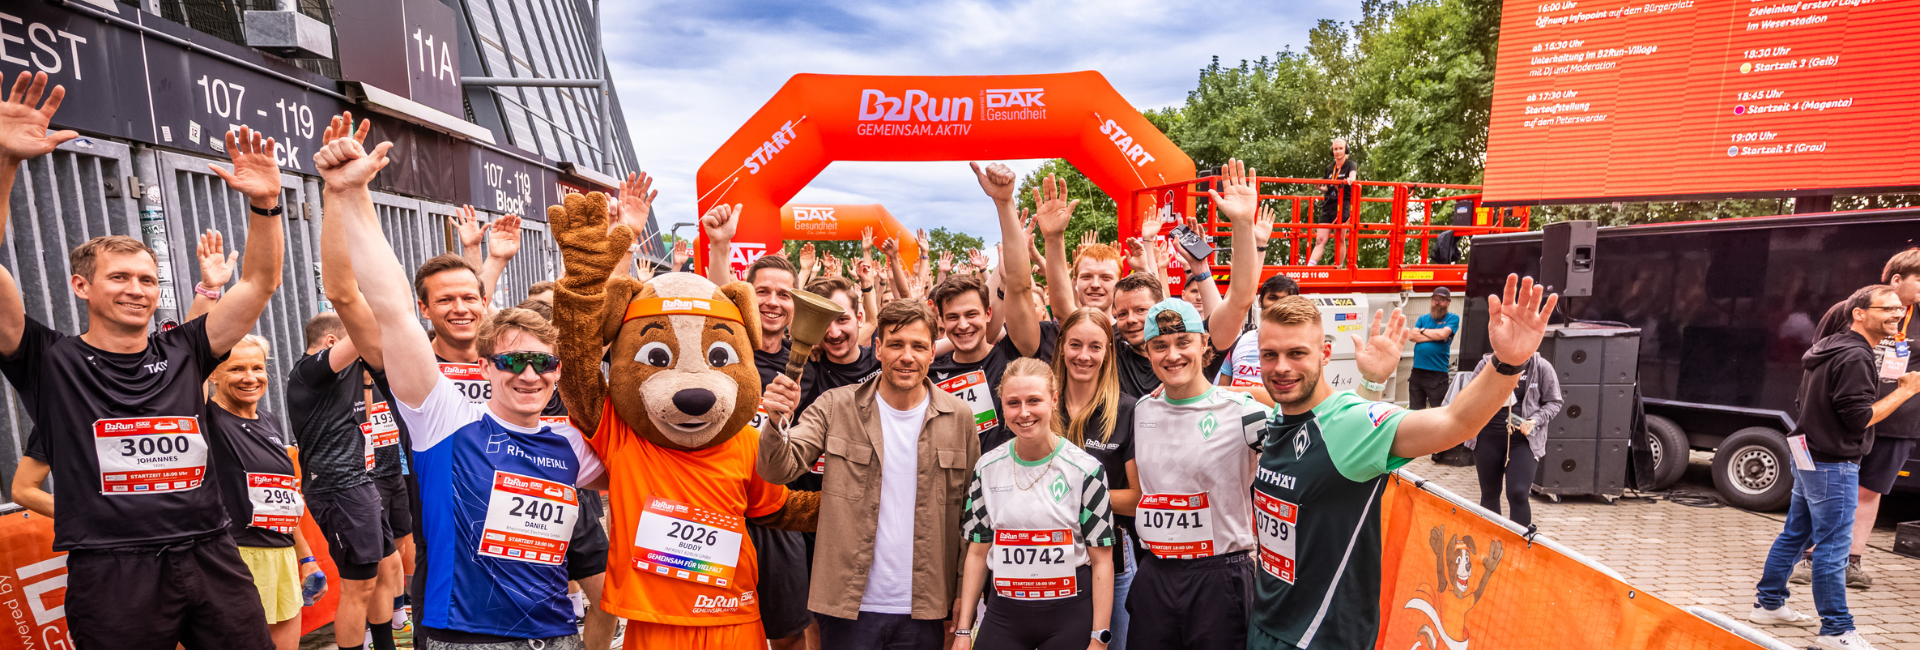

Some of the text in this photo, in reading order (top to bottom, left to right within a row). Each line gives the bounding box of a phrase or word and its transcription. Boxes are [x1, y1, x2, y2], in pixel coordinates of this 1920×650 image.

[1535, 0, 1695, 28] Öffnung Infopoint auf dem Bürgerplatz
[1538, 1, 1577, 13] 16:00 Uhr
[1748, 1, 1801, 17] Zieleinlauf
[1761, 14, 1828, 30] Weserstadion
[1532, 39, 1584, 52] ab 16:30 Uhr
[1743, 46, 1791, 59] 18:30 Uhr
[413, 28, 456, 87] 11A
[1531, 51, 1585, 65] Unterhaltung
[1597, 44, 1658, 58] B2Run-Village
[1529, 61, 1616, 77] mit DJ und Moderation
[1754, 55, 1839, 73] Startzeit 3 (Gelb)
[1526, 90, 1578, 102] ab 17:30 Uhr
[1737, 89, 1784, 101] 18:45 Uhr
[197, 75, 315, 140] 107 - 119
[858, 88, 1046, 122] B2Run DAK
[1525, 102, 1590, 115] Startaufstellung
[1747, 97, 1853, 115] Startzeit 4 (Magenta)
[986, 107, 1047, 121] Gesundheit
[1523, 118, 1537, 128] auf
[1538, 117, 1554, 126] dem
[1100, 118, 1156, 168] START
[1731, 131, 1777, 142] 19:00 Uhr
[744, 119, 797, 175] START
[1740, 141, 1826, 155] Startzeit 5 (Grau)
[484, 161, 503, 189] 107
[514, 171, 531, 196] 119
[495, 189, 526, 216] Block
[792, 207, 837, 221] DAK
[794, 220, 838, 230] Gesundheit
[708, 243, 767, 266] AK
[1286, 271, 1329, 279] 0800 20 11 600
[444, 366, 467, 374] B2Run
[1331, 374, 1340, 387] 4
[1346, 377, 1353, 385] 4
[120, 435, 190, 457] 3000
[137, 456, 178, 465] JOHANNES
[507, 444, 568, 470] RHMETALL
[195, 468, 201, 476] D
[503, 476, 529, 488] B2Run
[509, 497, 564, 525] 2401
[652, 499, 675, 510] B2Run
[524, 521, 548, 530] DANIEL
[1143, 511, 1203, 529] 10741
[506, 525, 530, 534] Rheinmetall
[530, 529, 550, 537] Electronics
[666, 521, 718, 546] 2026
[508, 536, 534, 545] STARTZEIT
[559, 543, 565, 551] D
[664, 546, 685, 554] INFRONT
[678, 541, 702, 552] BUDDY
[1200, 542, 1208, 550] D
[647, 552, 723, 574] GEMEINSAM FÜR VIELFALT
[1002, 547, 1065, 565] 10742
[1285, 559, 1290, 568] D
[1063, 578, 1070, 586] D
[694, 594, 738, 608] B2Run
[3, 599, 37, 650] wered
